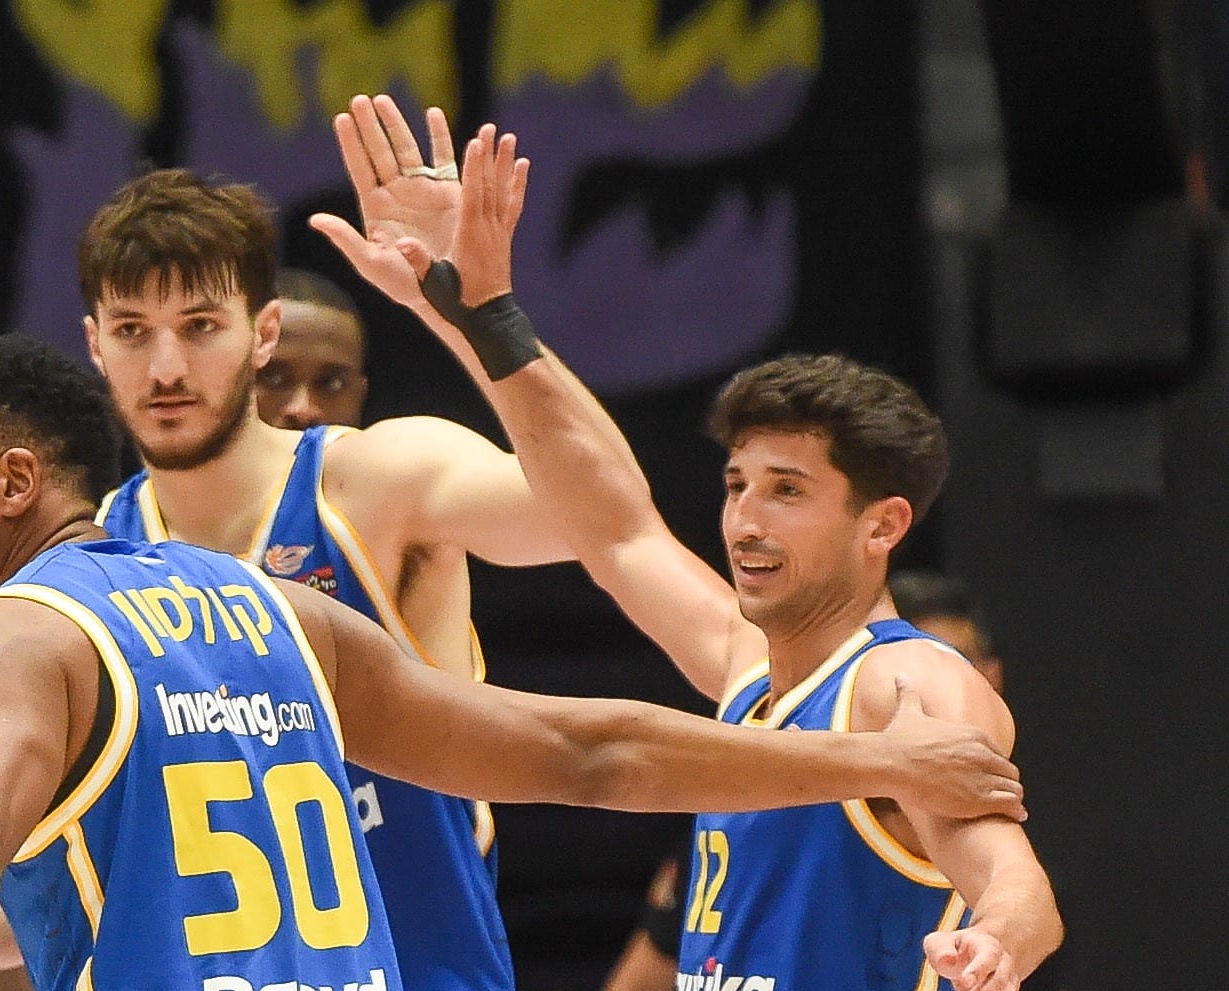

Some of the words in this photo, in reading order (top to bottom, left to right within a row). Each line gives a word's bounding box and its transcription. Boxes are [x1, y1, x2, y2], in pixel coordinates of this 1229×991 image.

[108, 576, 273, 658] קולסון
[155, 683, 315, 747] Inveting.com
[162, 760, 370, 957] 50
[686, 831, 730, 933] 12
